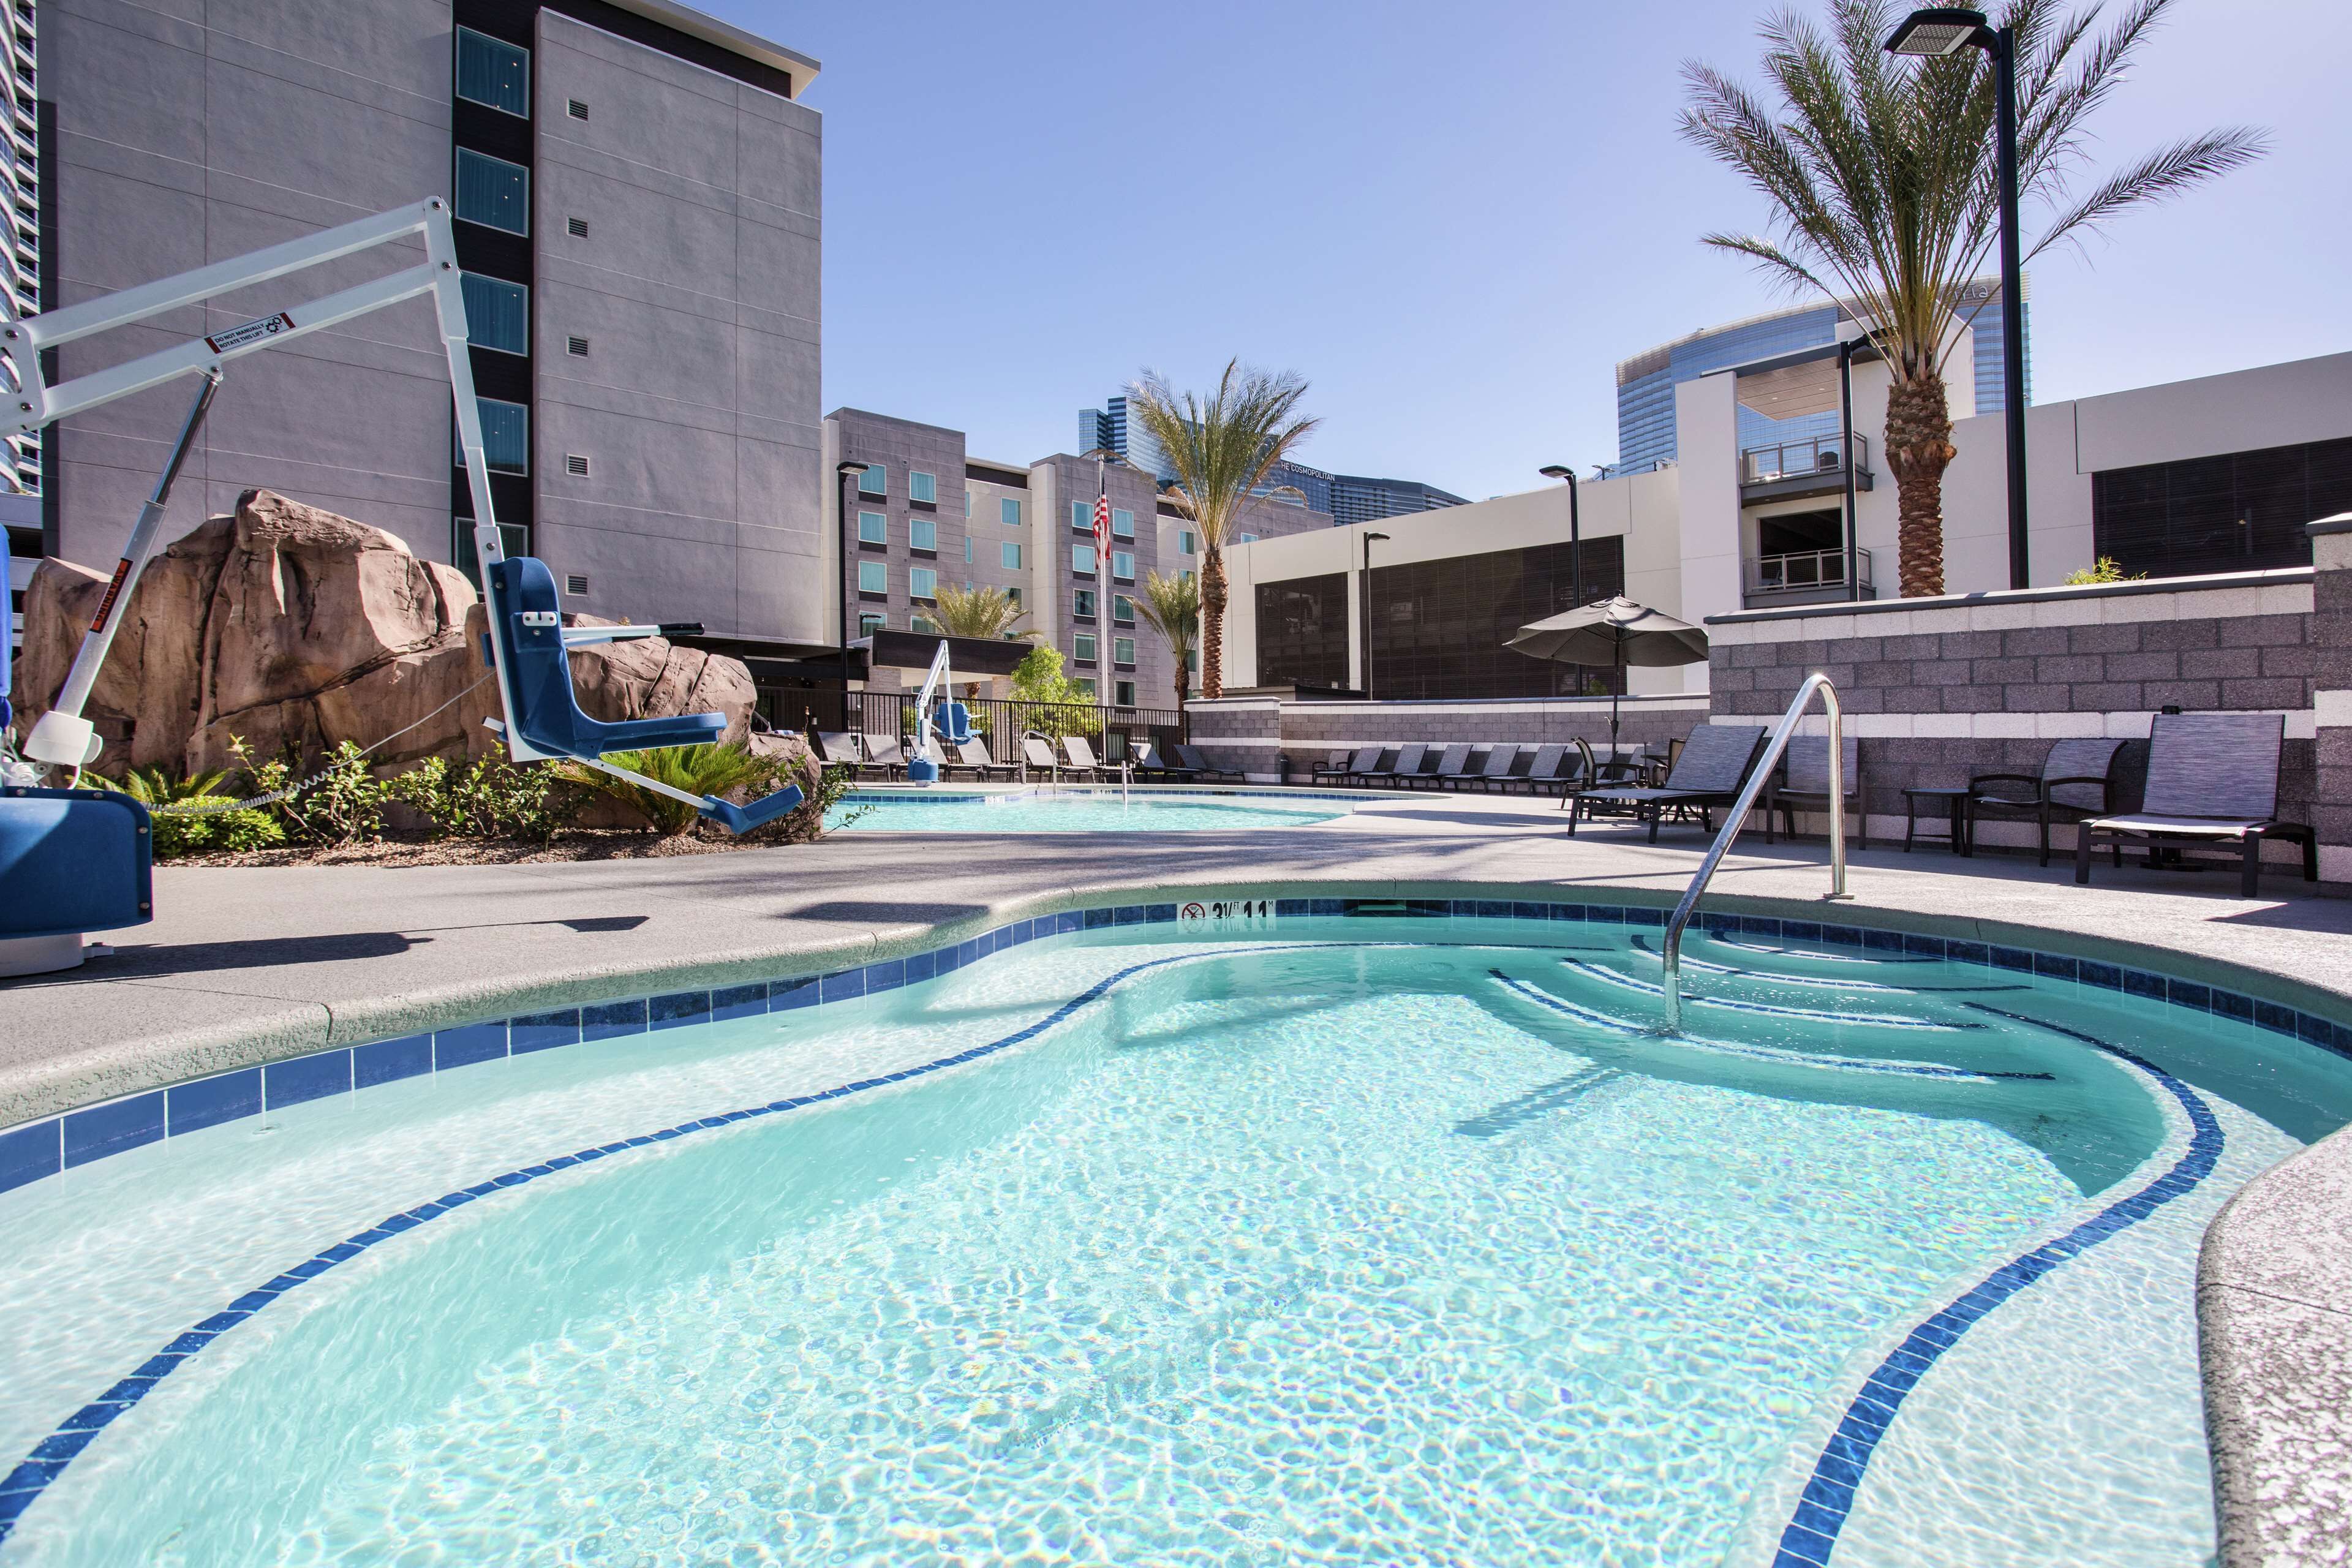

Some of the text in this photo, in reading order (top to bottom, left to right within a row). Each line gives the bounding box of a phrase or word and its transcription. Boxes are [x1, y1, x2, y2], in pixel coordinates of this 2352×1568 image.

[236, 323, 265, 336] MANUALLY
[219, 338, 240, 349] ROTATE
[1280, 461, 1335, 481] HE COSMOPOLITAN
[96, 575, 121, 620] WARNING
